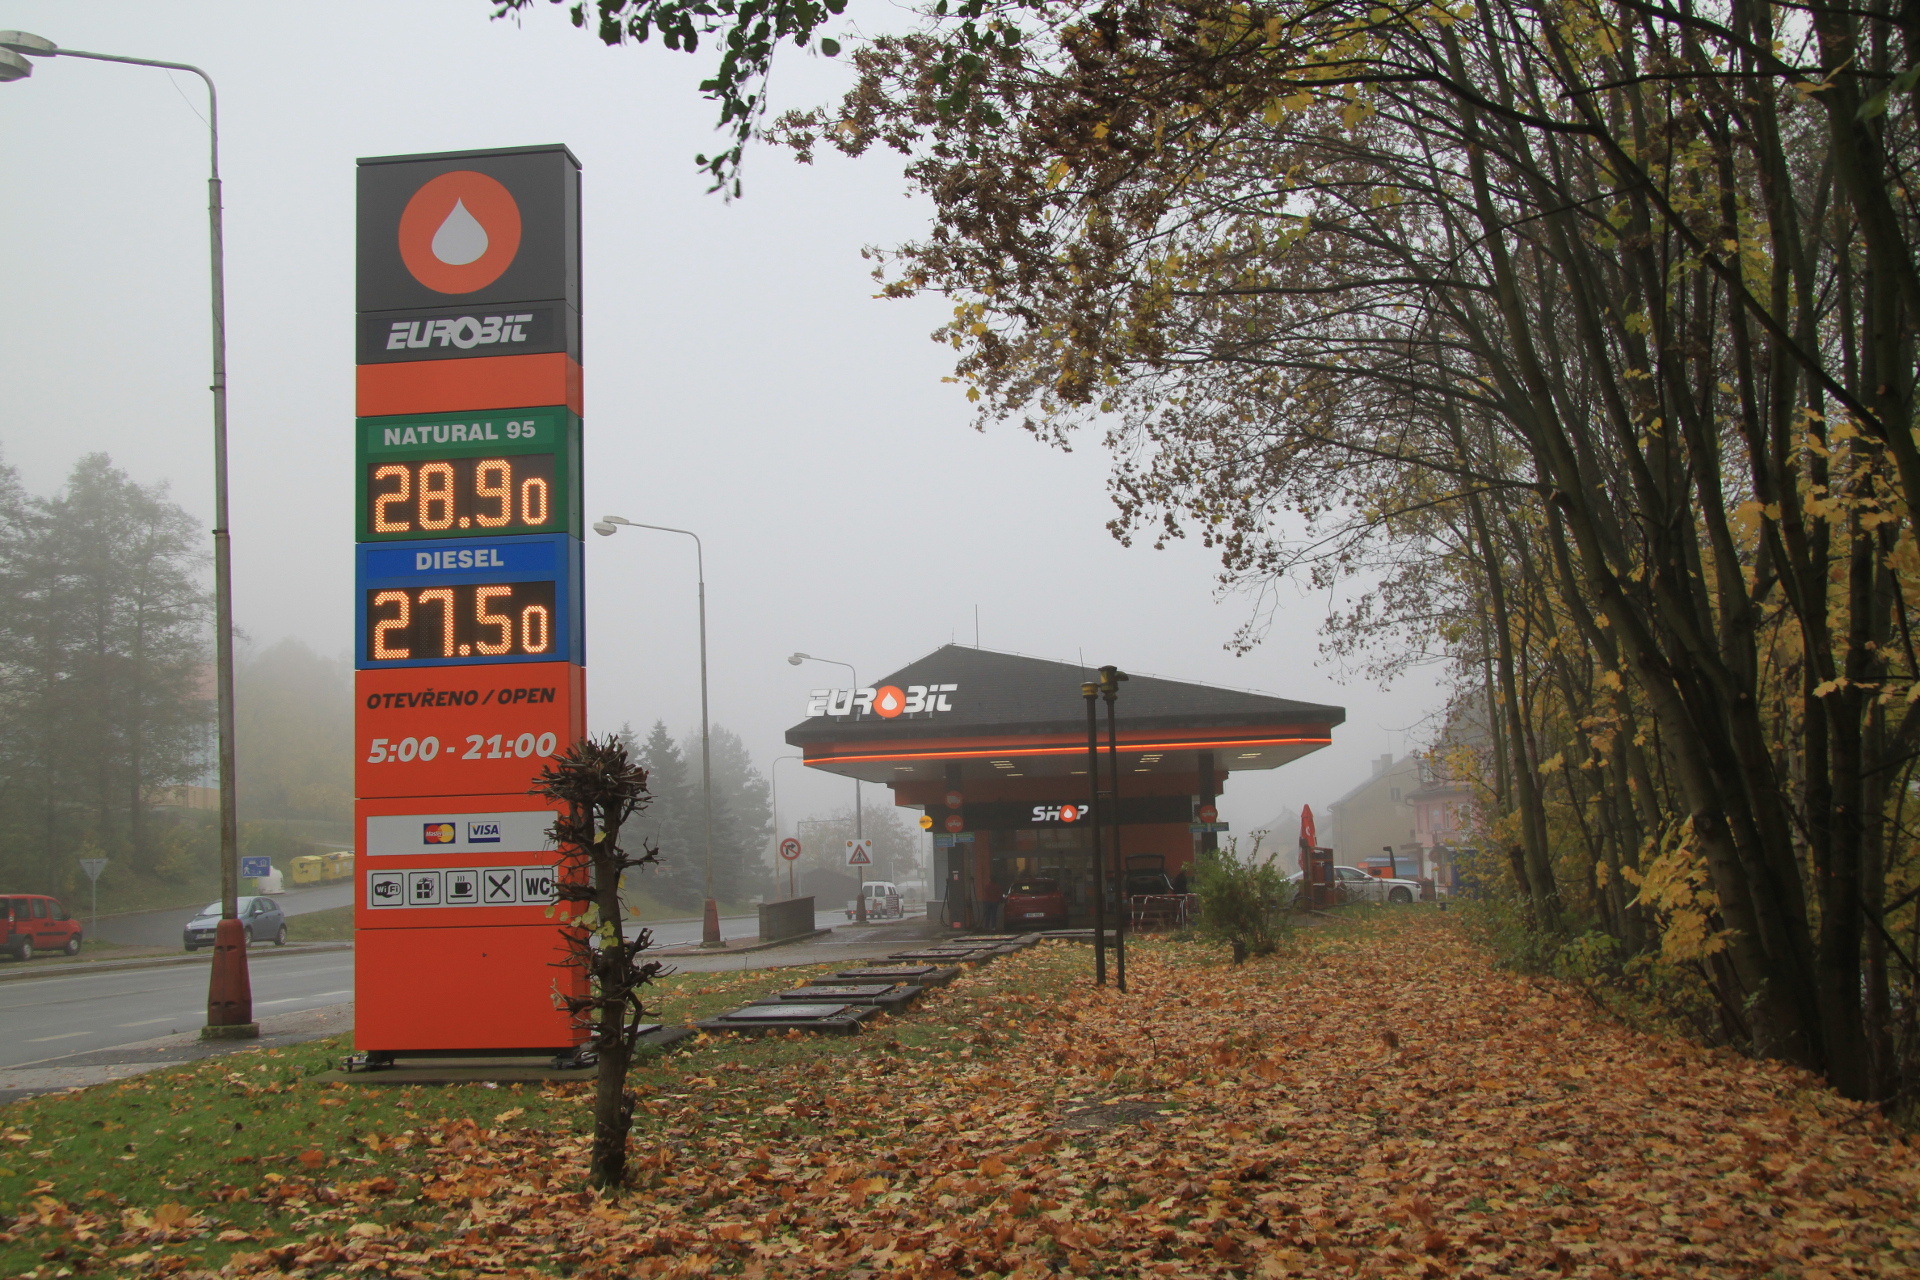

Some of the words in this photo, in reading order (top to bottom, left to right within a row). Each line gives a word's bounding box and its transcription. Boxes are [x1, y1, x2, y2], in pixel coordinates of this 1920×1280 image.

[383, 422, 499, 446] NATURAL
[506, 421, 537, 439] 95
[374, 459, 548, 533] 28.90
[415, 549, 505, 571] DIESEL
[374, 586, 549, 660] 27.50
[366, 687, 479, 709] OTEVŘENO
[481, 689, 495, 705] /
[497, 688, 556, 704] OPEN
[367, 736, 440, 763] 5:00
[461, 731, 557, 760] 21:00
[1031, 804, 1089, 823] SHOP
[471, 824, 499, 836] VISA
[525, 877, 551, 896] WC
